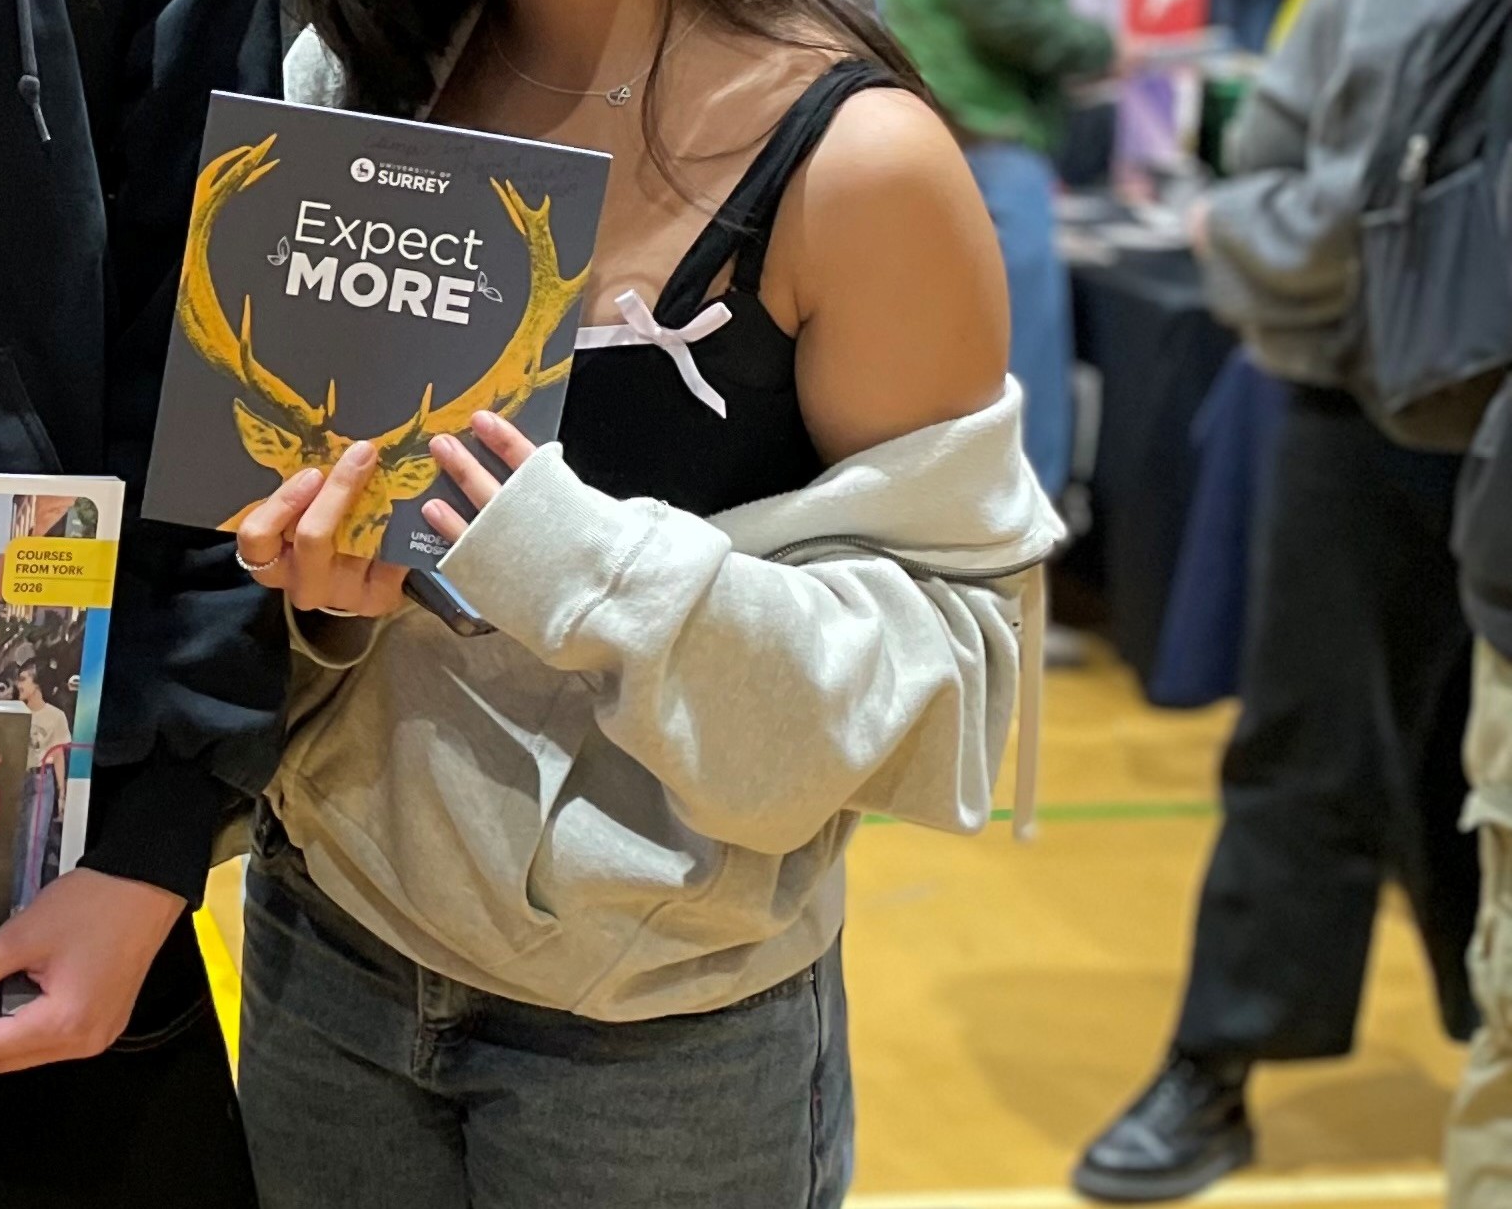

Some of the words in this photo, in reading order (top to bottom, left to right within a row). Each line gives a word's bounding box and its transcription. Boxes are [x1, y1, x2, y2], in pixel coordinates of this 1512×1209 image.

[377, 169, 450, 194] SURREY
[295, 200, 483, 270] Expect
[285, 251, 475, 325] MORE
[16, 550, 73, 561] COURSES
[15, 563, 49, 574] FROM
[52, 564, 84, 575] YORK
[13, 583, 43, 593] 2026
